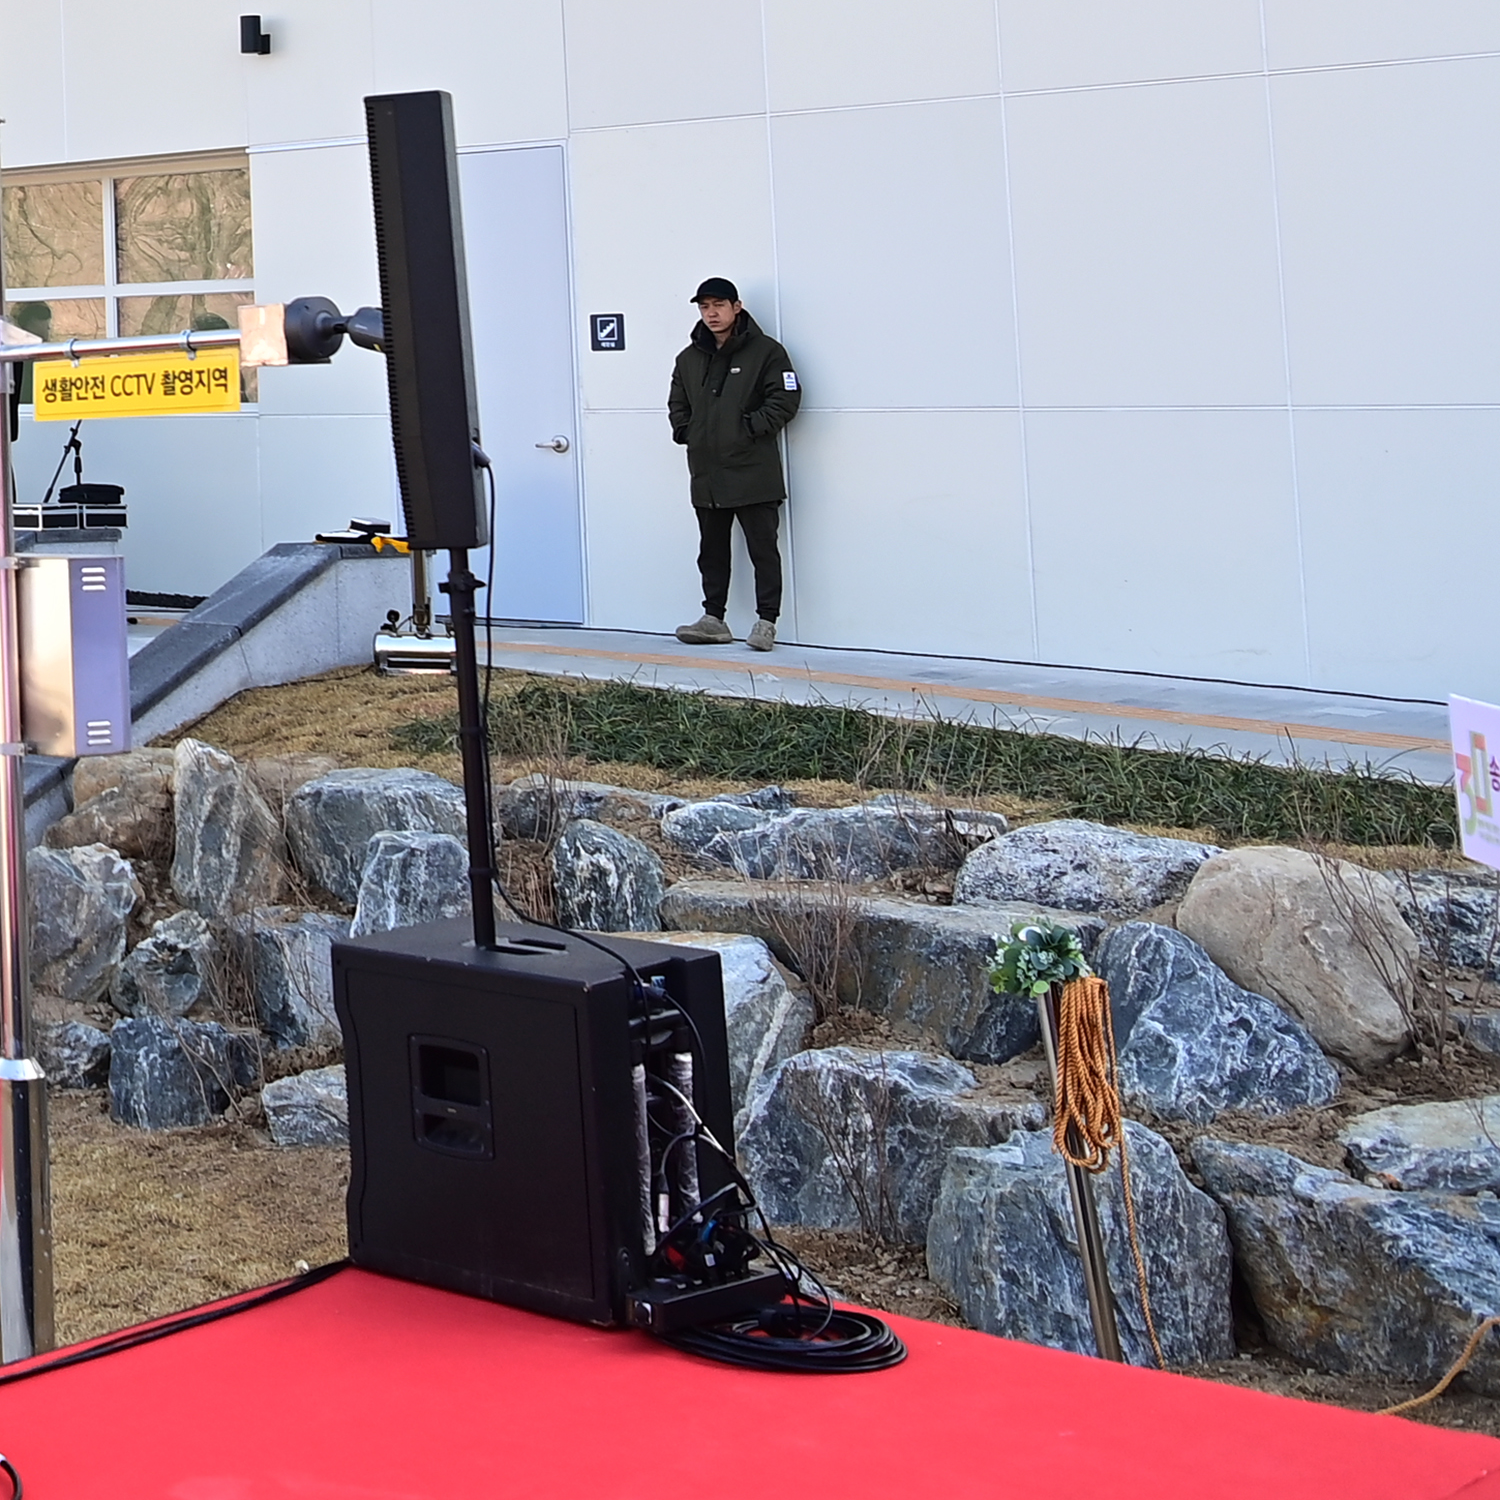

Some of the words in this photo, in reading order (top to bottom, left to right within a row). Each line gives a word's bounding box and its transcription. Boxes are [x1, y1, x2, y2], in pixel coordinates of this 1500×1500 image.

[42, 375, 105, 404] 생활안전
[110, 373, 155, 398] CCTV
[160, 367, 229, 396] 촬영지역
